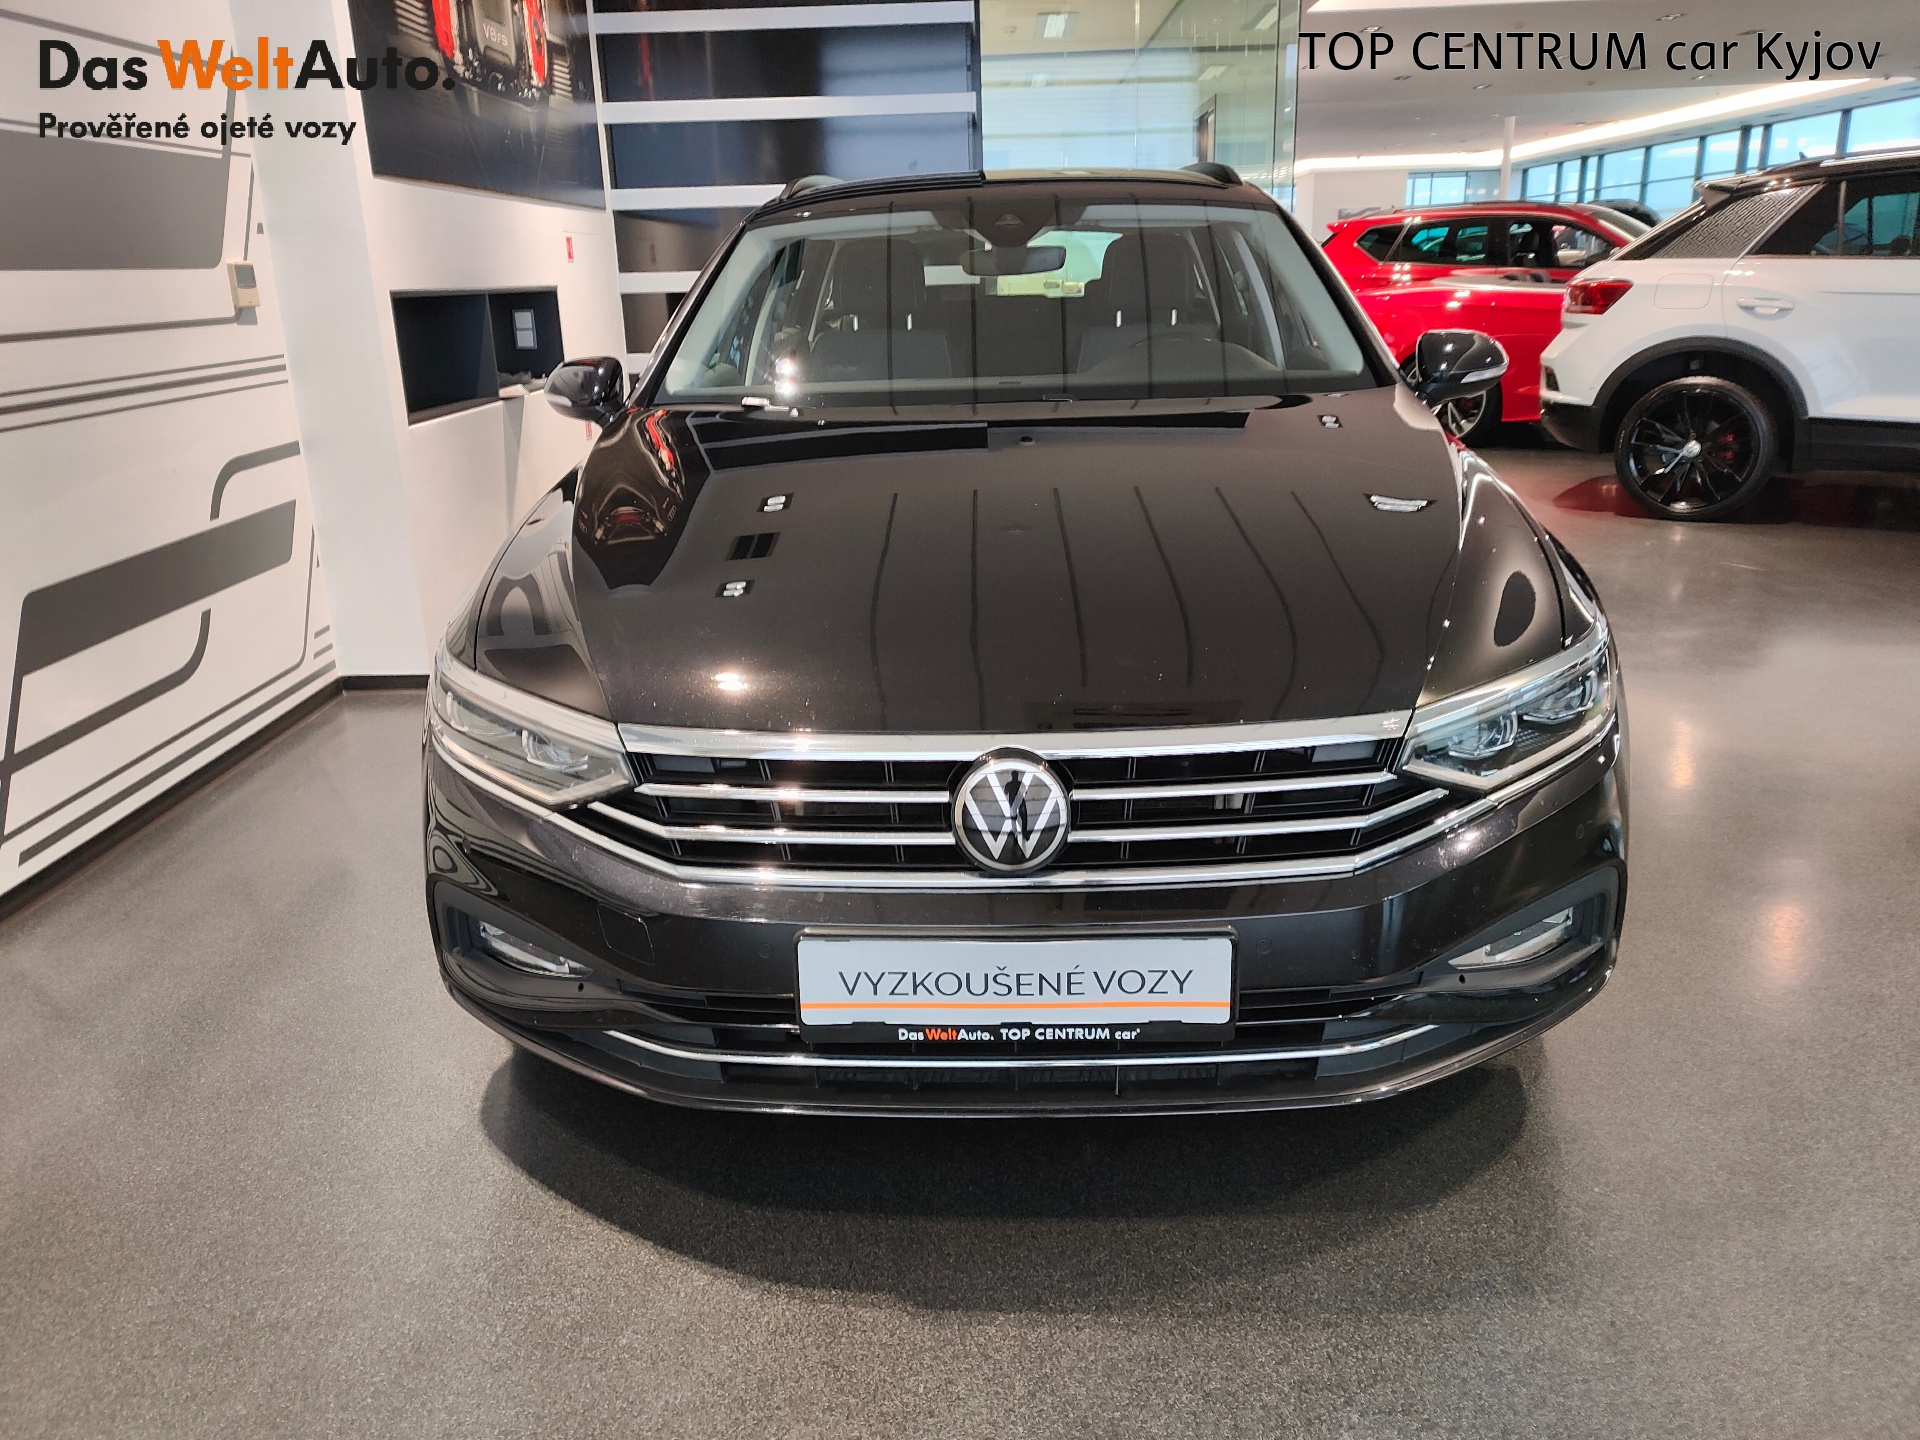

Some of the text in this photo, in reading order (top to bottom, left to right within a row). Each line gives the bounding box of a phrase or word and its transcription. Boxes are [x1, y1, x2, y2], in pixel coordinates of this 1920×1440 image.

[838, 964, 1194, 997] VYZKOUŠENÉ VOZY
[898, 1028, 924, 1041] Das
[1000, 1027, 1031, 1041] TOP
[1035, 1027, 1111, 1041] CENTRUM
